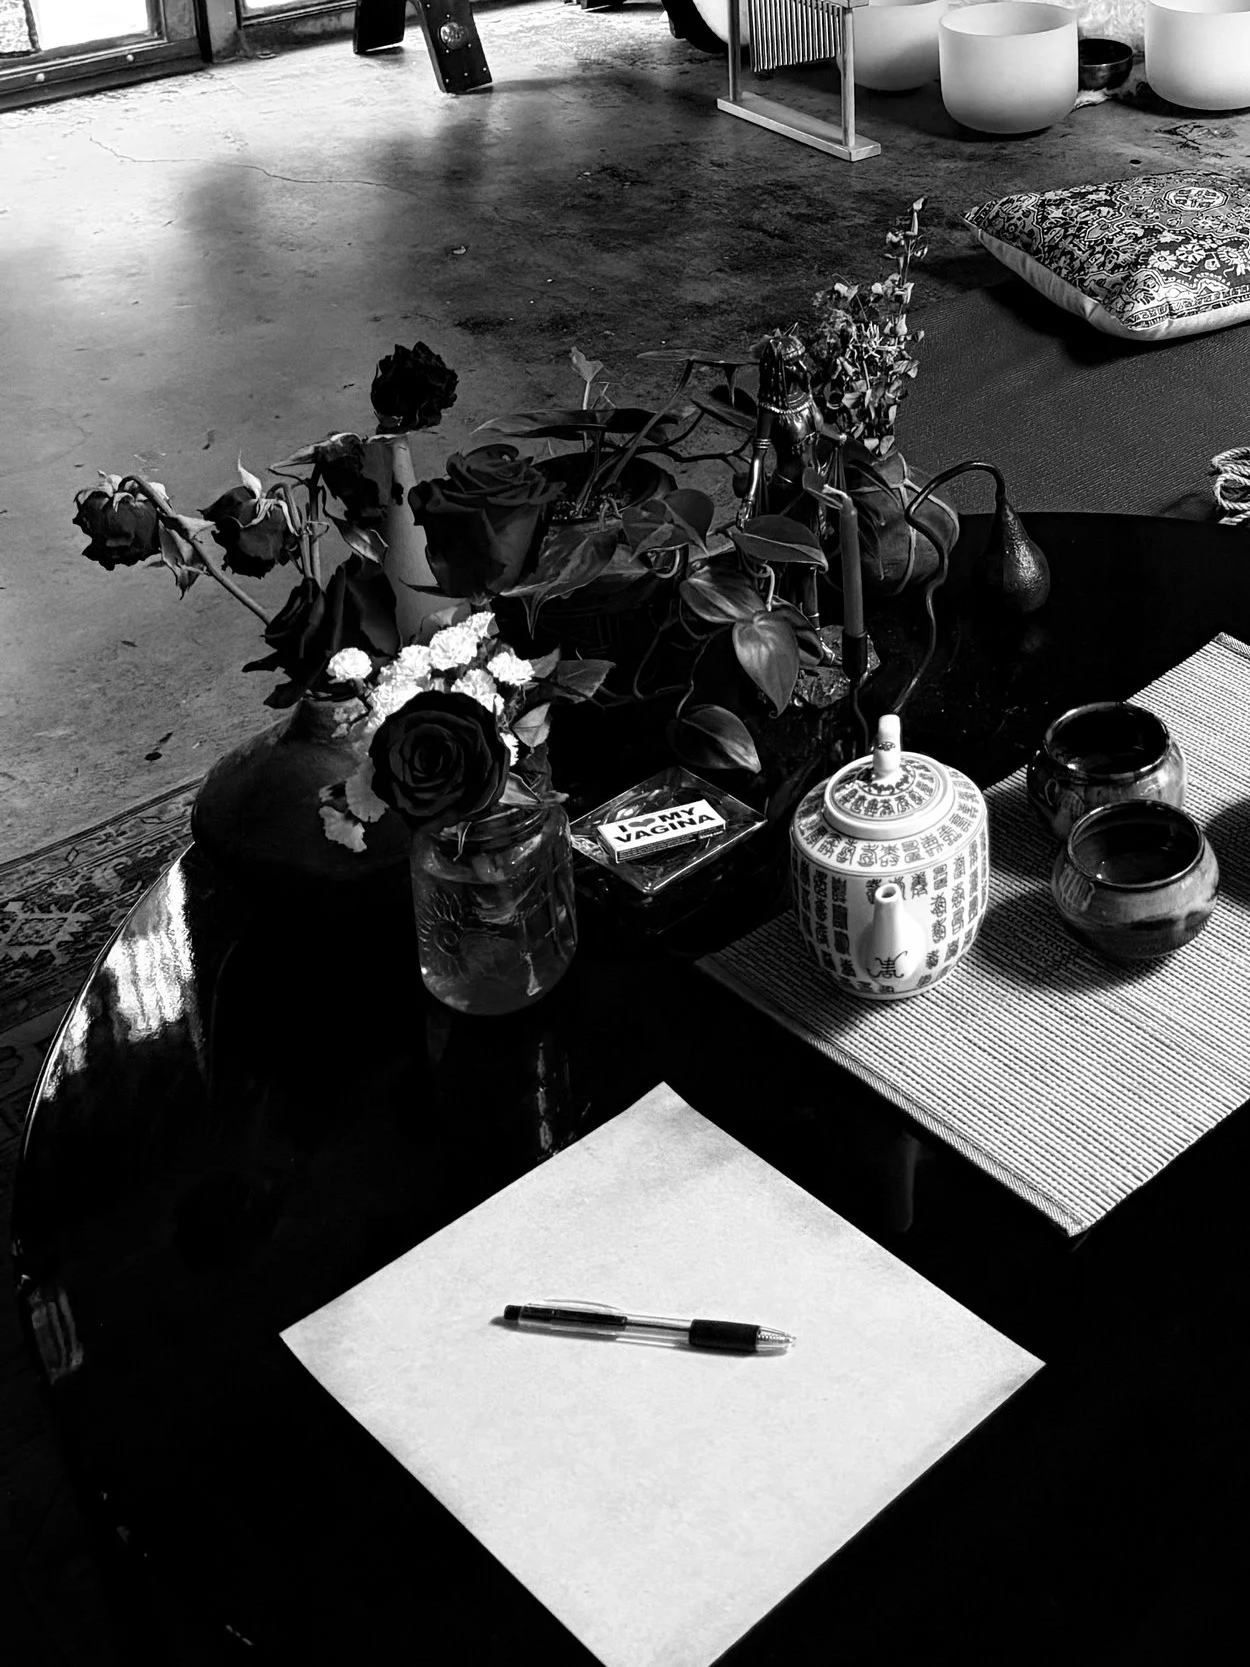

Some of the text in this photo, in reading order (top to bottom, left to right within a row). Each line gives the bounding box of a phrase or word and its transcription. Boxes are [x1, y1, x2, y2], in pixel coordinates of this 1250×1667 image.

[614, 814, 717, 843] VAGINA
[618, 806, 696, 833] I MY
